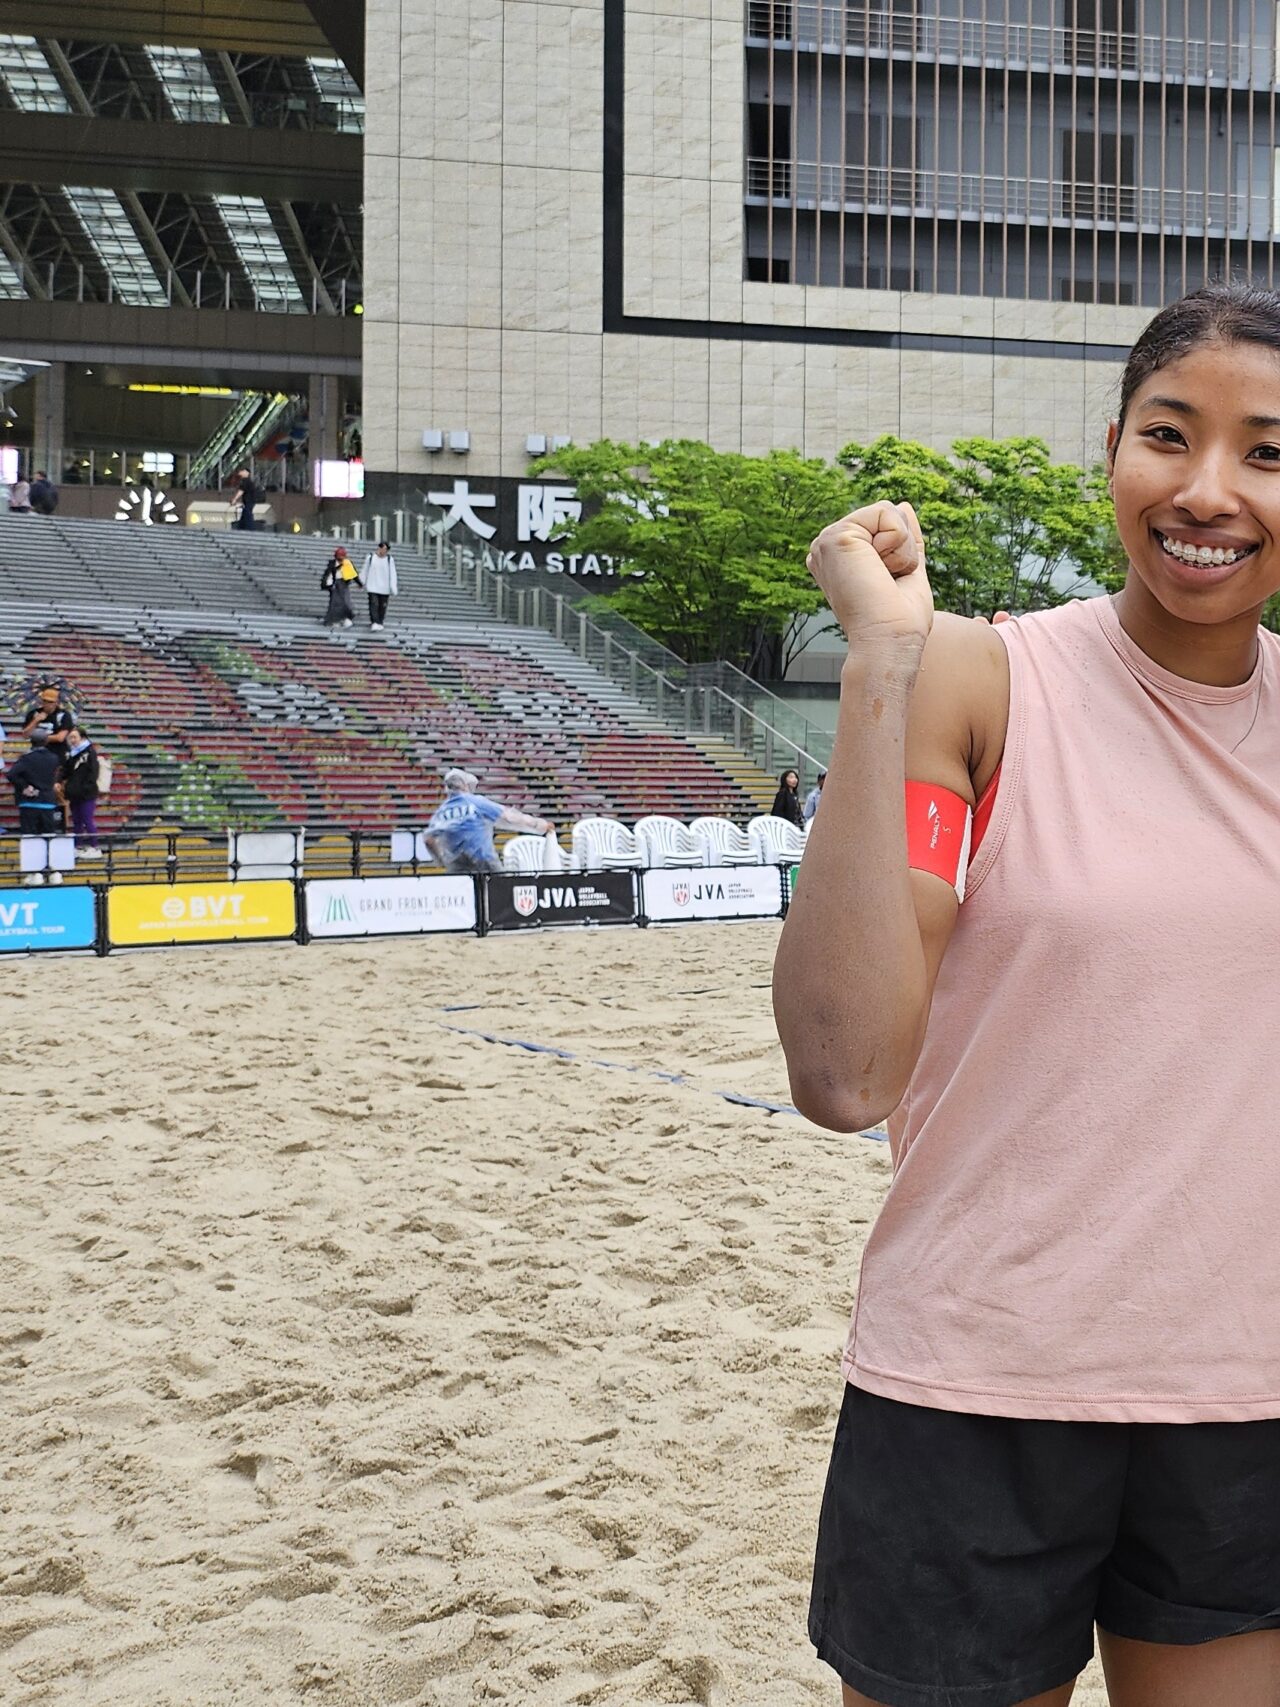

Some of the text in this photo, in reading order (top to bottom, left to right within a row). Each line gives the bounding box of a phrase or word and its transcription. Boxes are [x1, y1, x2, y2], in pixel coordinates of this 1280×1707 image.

[427, 480, 670, 542] 大阪
[930, 814, 941, 849] PENALTY
[539, 887, 576, 908] JVA
[694, 884, 725, 900] JVA
[190, 895, 244, 917] BVT
[360, 895, 466, 912] GRAND FRONT OSAKA
